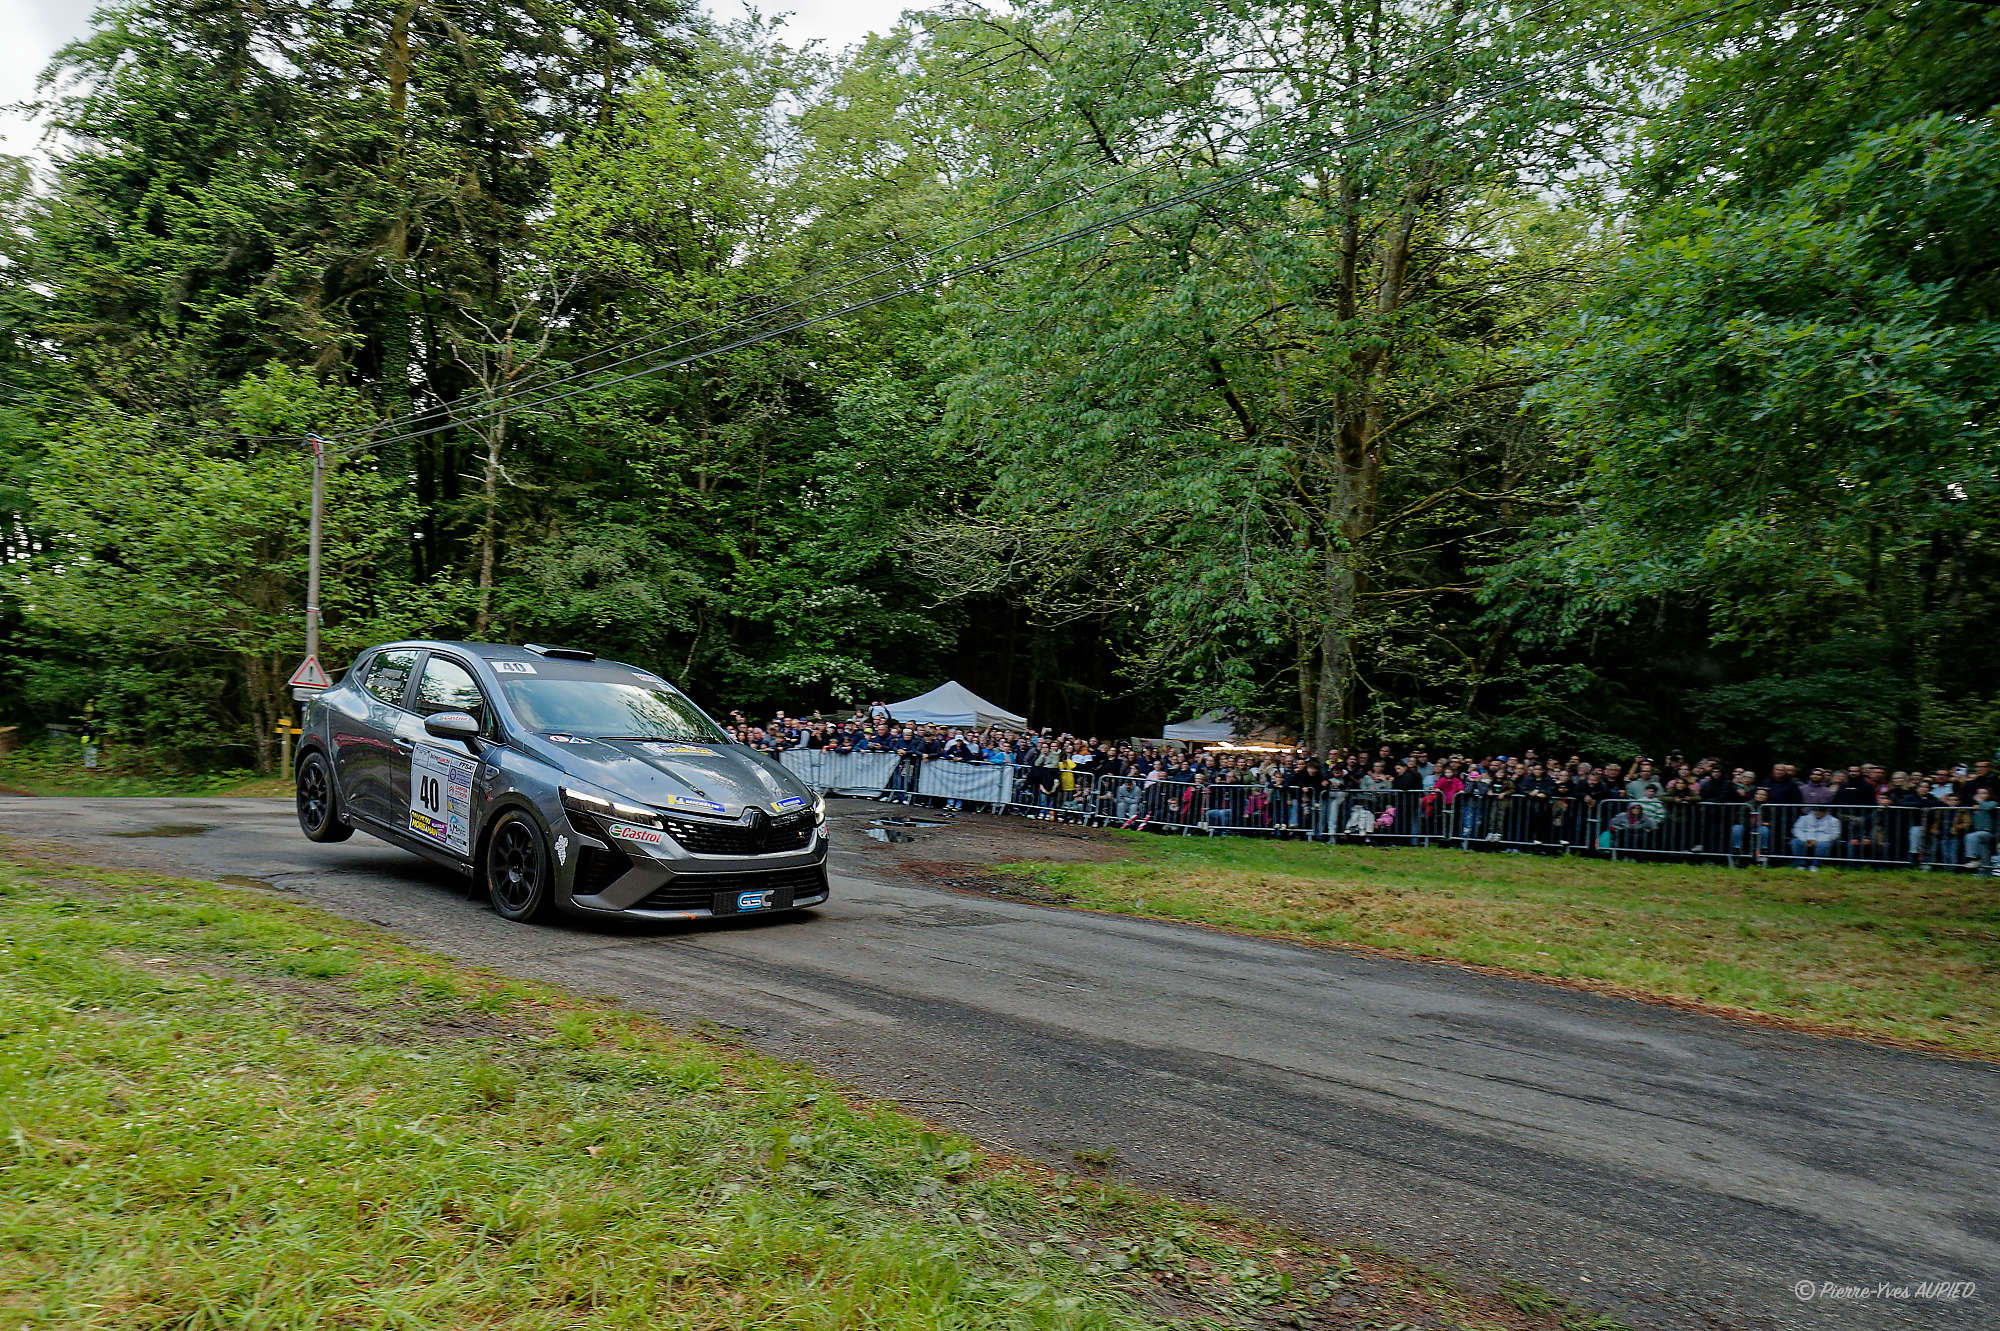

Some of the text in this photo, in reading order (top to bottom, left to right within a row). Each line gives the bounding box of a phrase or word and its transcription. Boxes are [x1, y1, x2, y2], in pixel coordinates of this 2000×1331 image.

[503, 662, 527, 672] 40
[420, 775, 439, 813] 40
[622, 827, 661, 843] Castrol
